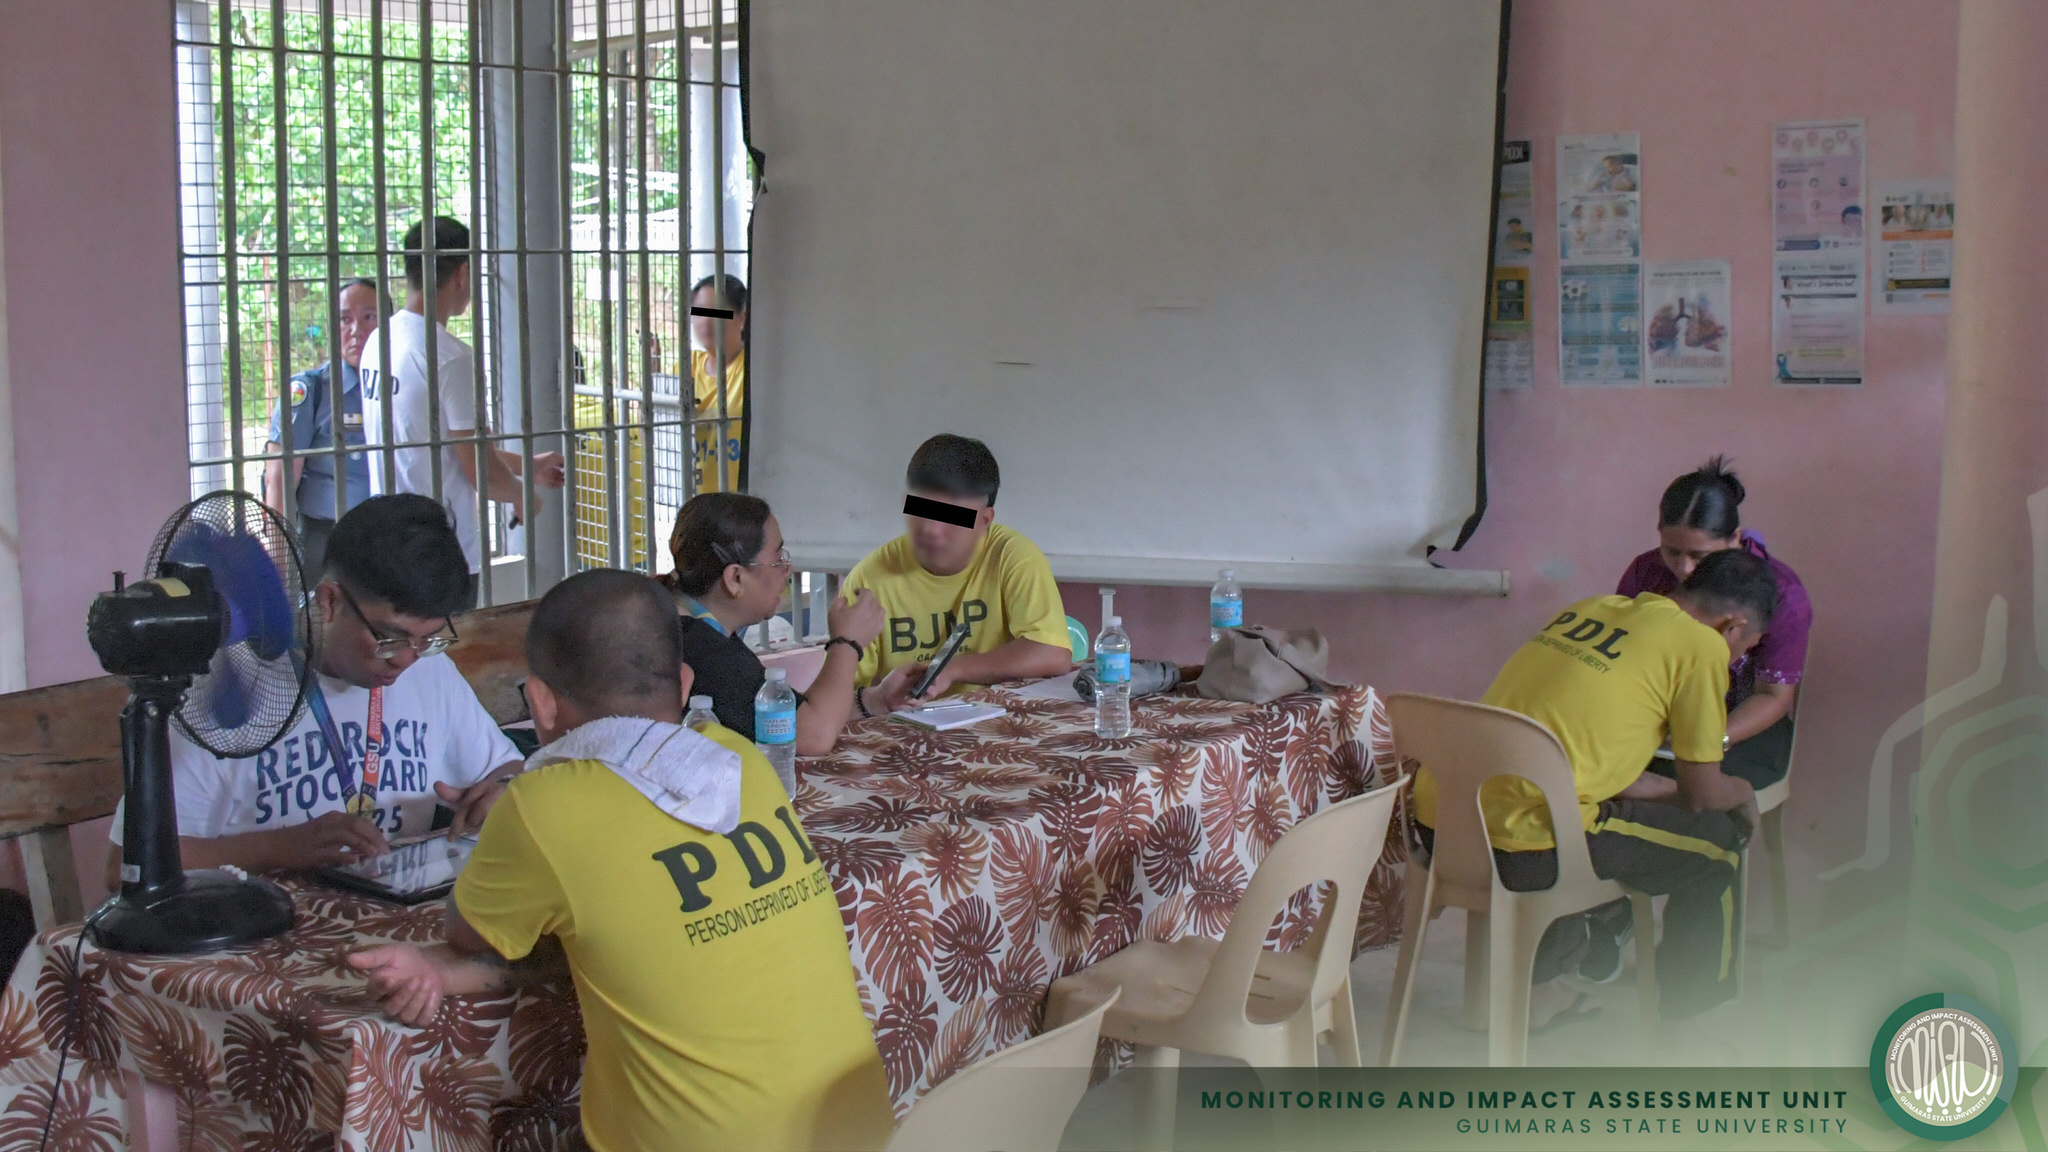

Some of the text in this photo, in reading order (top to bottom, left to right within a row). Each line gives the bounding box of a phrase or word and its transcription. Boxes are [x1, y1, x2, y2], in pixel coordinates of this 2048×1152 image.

[1541, 611, 1629, 660] PDL
[256, 730, 329, 790] RED
[366, 742, 380, 774] GSU
[684, 905, 748, 946] PERSON
[744, 884, 798, 925] DEPRIVED
[795, 878, 810, 902] OF
